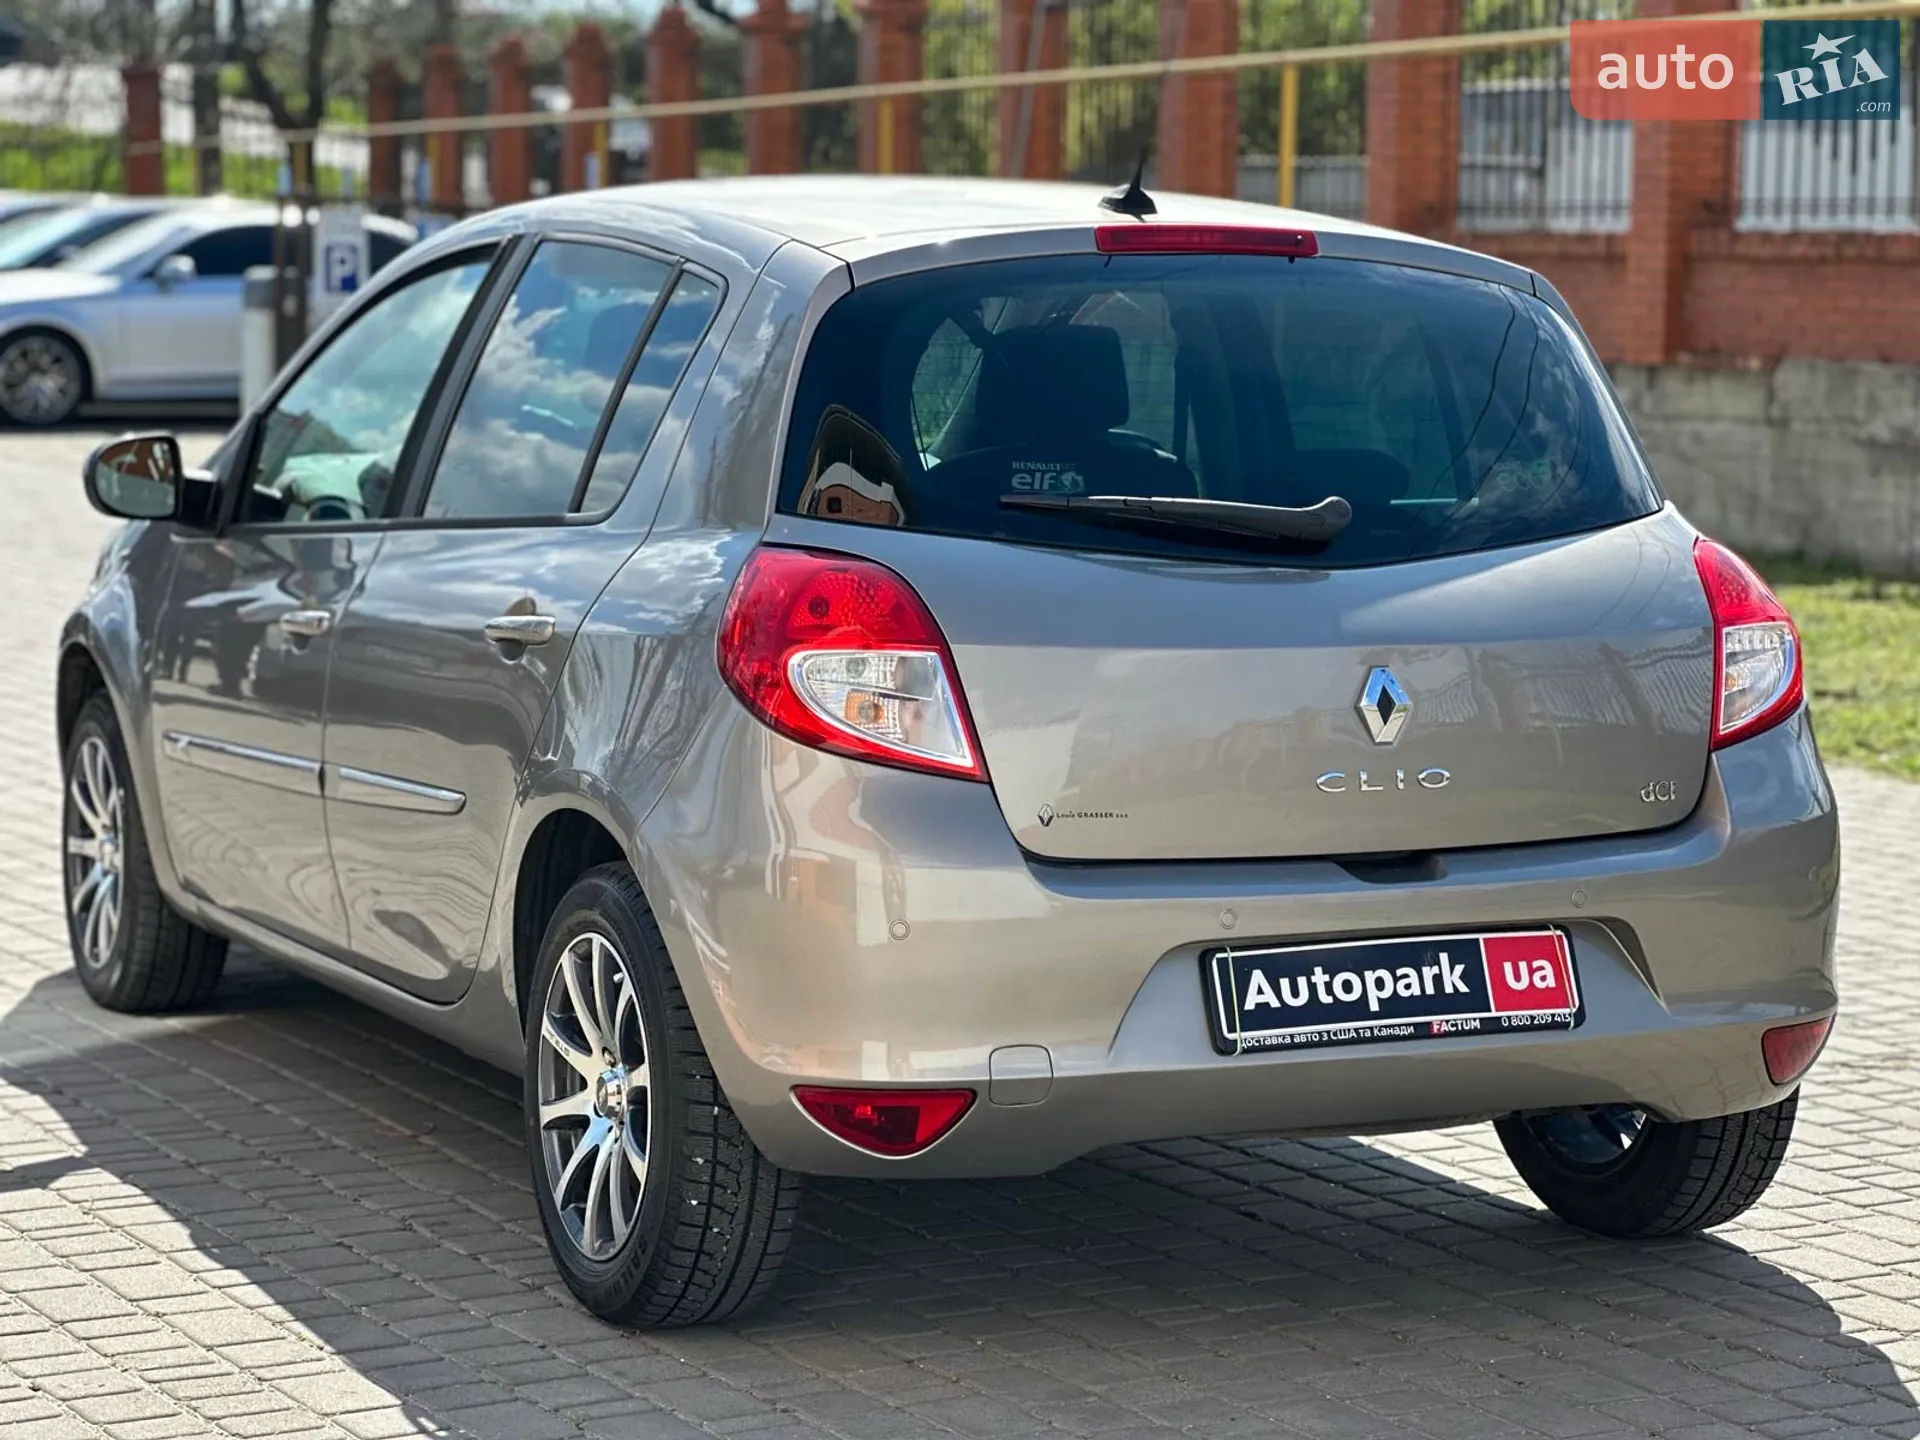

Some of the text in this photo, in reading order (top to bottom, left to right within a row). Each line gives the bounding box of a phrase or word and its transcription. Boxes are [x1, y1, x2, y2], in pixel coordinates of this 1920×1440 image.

[330, 246, 355, 288] P
[1012, 461, 1060, 471] RENAULT
[1011, 471, 1056, 490] elf
[1316, 767, 1450, 791] CLIO
[1641, 780, 1676, 802] dCi
[1077, 811, 1113, 819] GRASSER
[1243, 951, 1557, 1012] Autopark ua
[1432, 1018, 1481, 1033] FACTUM
[1501, 1012, 1571, 1027] 0 800 209 413
[1293, 1032, 1319, 1043] авто
[1322, 1032, 1328, 1041] з
[1330, 1028, 1357, 1040] США
[1360, 1029, 1371, 1038] та
[1373, 1024, 1415, 1037] Канади
